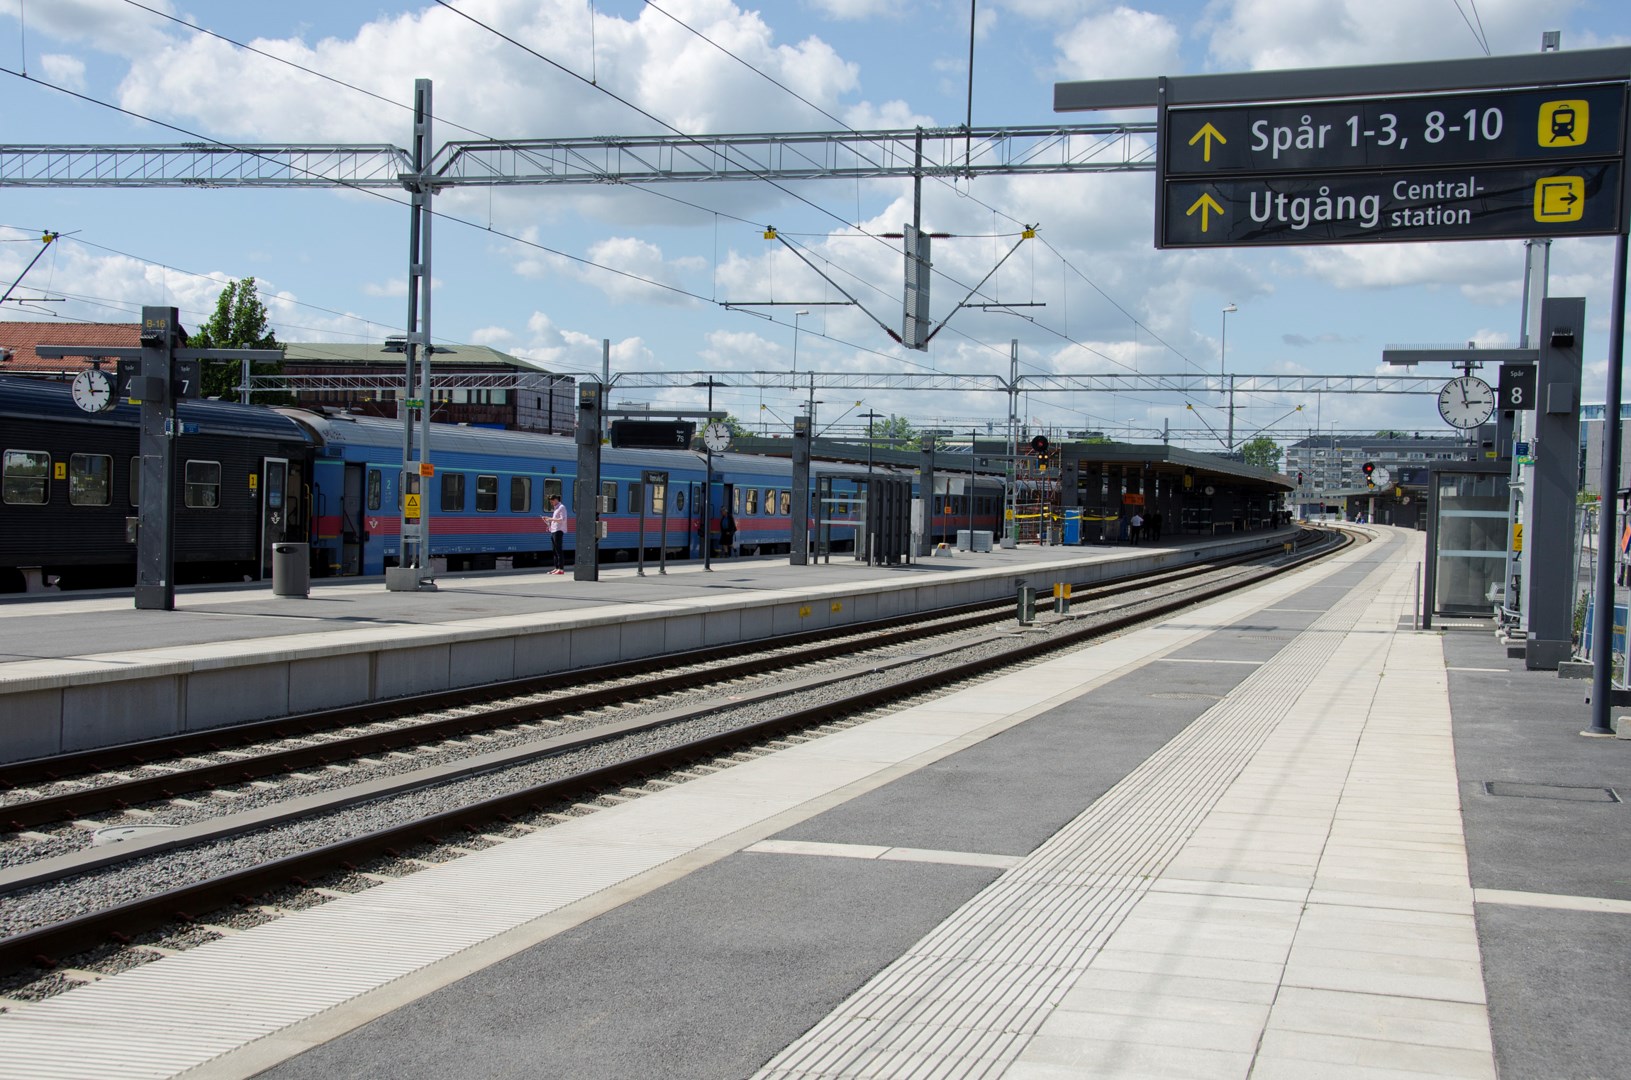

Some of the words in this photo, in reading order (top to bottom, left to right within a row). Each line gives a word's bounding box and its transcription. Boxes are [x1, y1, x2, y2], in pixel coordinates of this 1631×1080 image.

[1251, 114, 1331, 159] Spår
[1345, 112, 1408, 149] 1-3,
[1423, 107, 1504, 144] 8-10
[1392, 176, 1485, 200] Central-
[1249, 185, 1380, 230] Utgång
[1391, 205, 1471, 228] station
[146, 319, 166, 328] B-16
[1510, 370, 1525, 378] Spår
[181, 379, 190, 394] 7
[1511, 387, 1523, 404] 8
